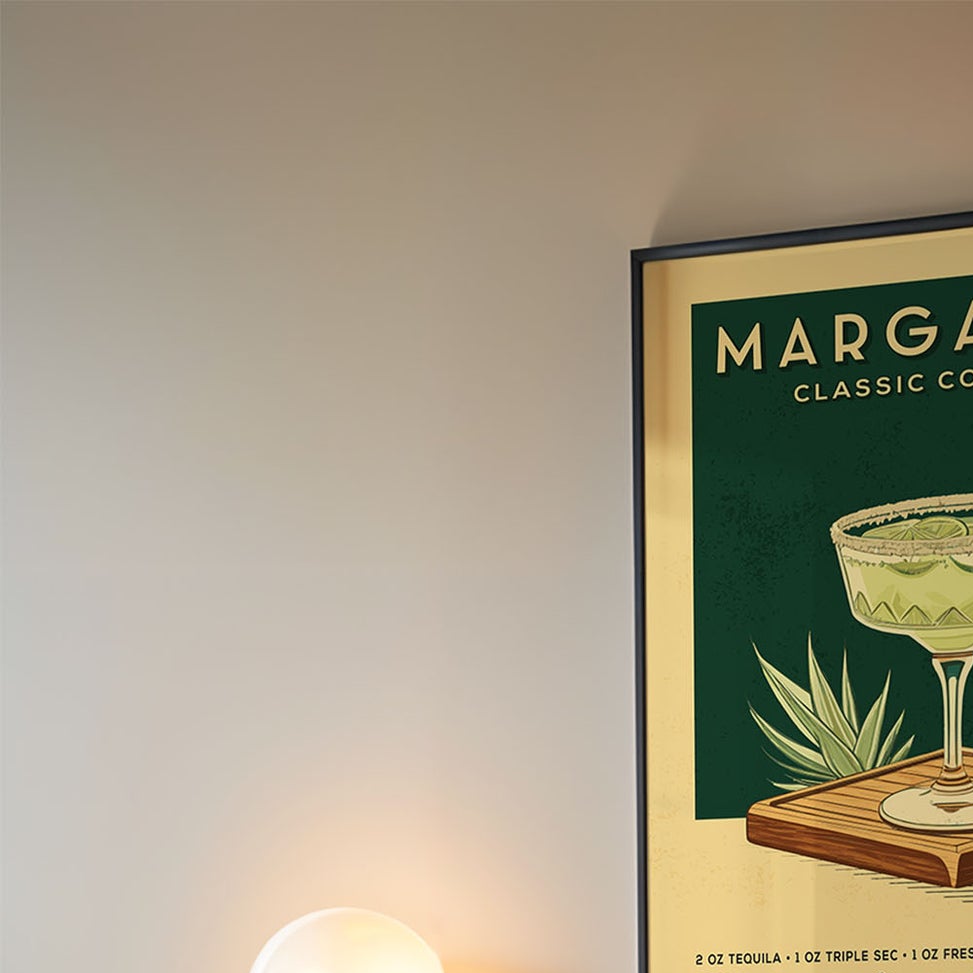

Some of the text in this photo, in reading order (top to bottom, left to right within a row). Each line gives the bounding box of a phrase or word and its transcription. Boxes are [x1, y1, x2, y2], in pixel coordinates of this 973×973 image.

[793, 373, 926, 403] CLASSIC
[695, 954, 704, 965] 2
[708, 953, 724, 965] OZ
[728, 952, 782, 964] TEQUILA
[795, 952, 800, 963] 1
[804, 951, 821, 963] OZ
[826, 950, 869, 962] TRIPLE
[873, 949, 898, 961] SEC
[911, 949, 917, 960] 1
[921, 948, 938, 960] OZ
